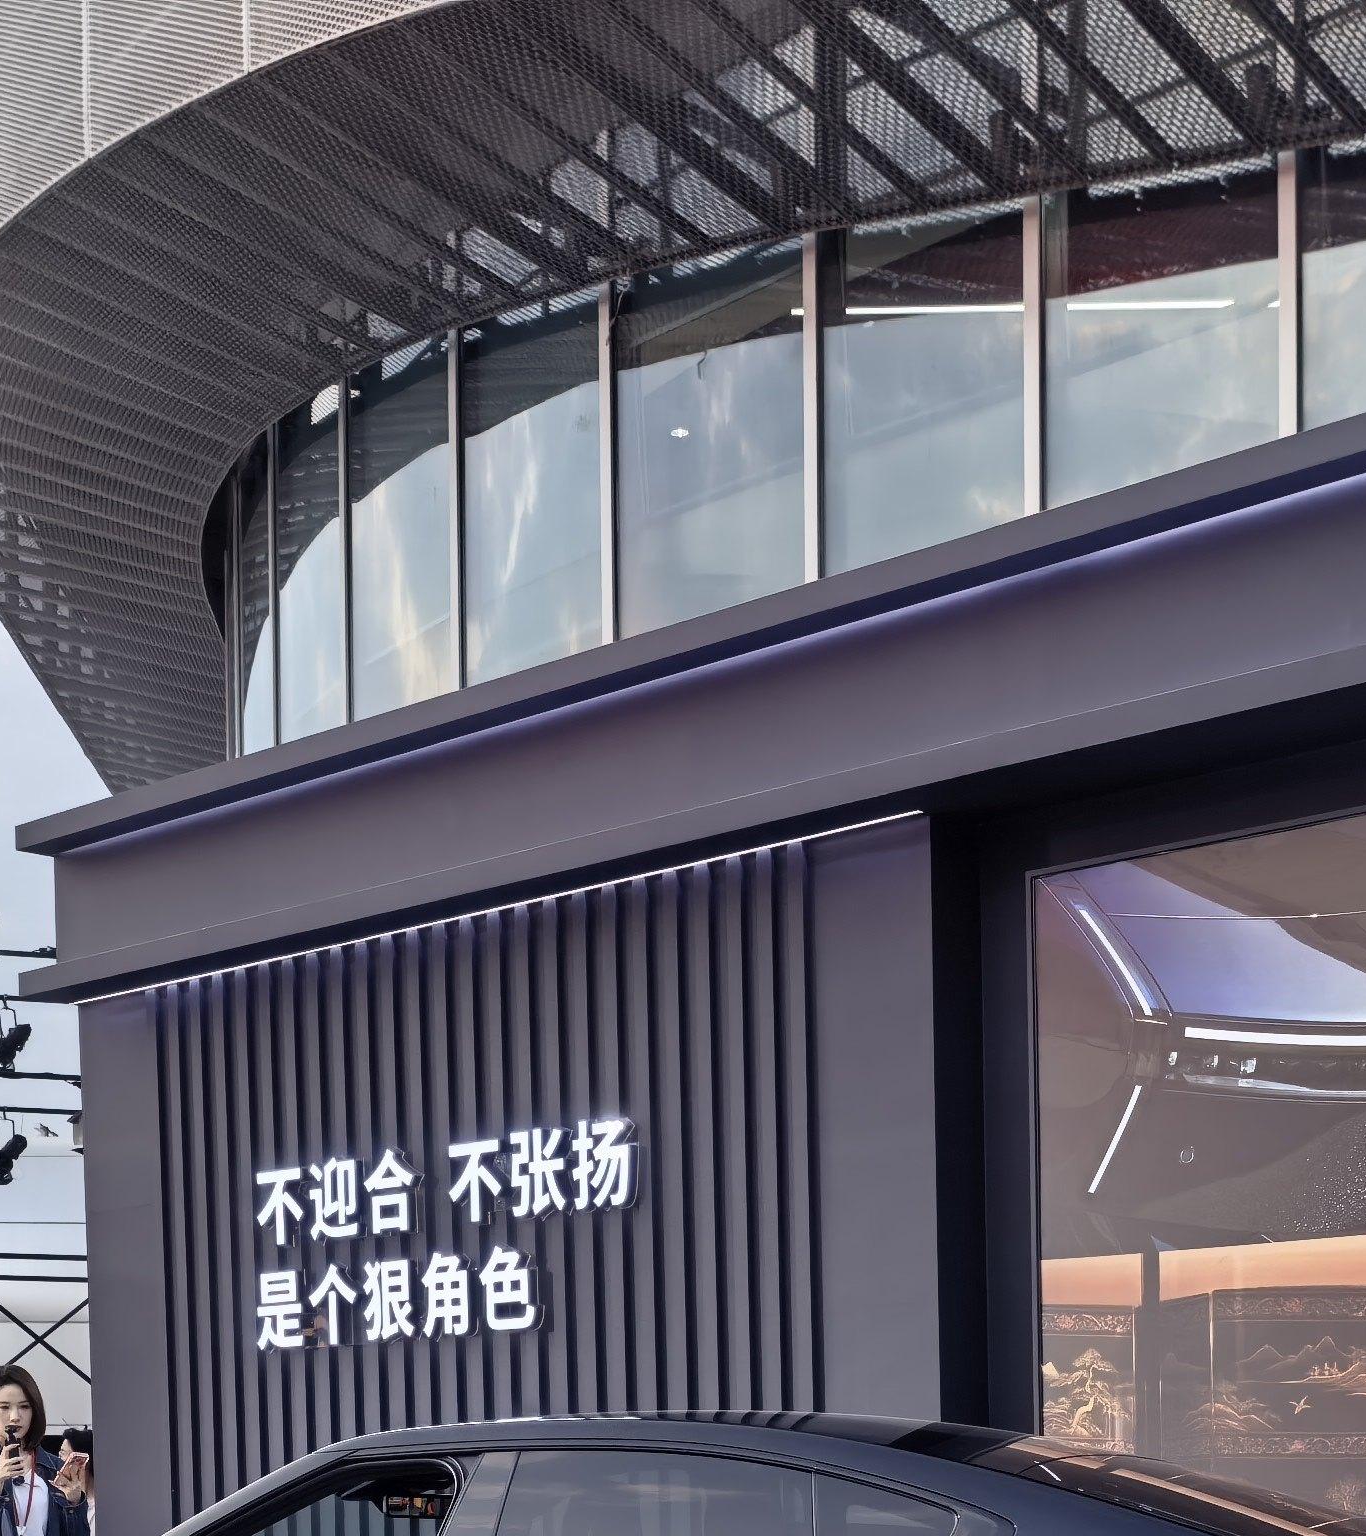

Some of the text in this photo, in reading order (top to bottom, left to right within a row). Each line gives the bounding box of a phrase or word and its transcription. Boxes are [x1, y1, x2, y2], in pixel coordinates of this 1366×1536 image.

[255, 1117, 633, 1246] 不迎合 不张扬
[256, 1245, 536, 1350] 是个狠角色
